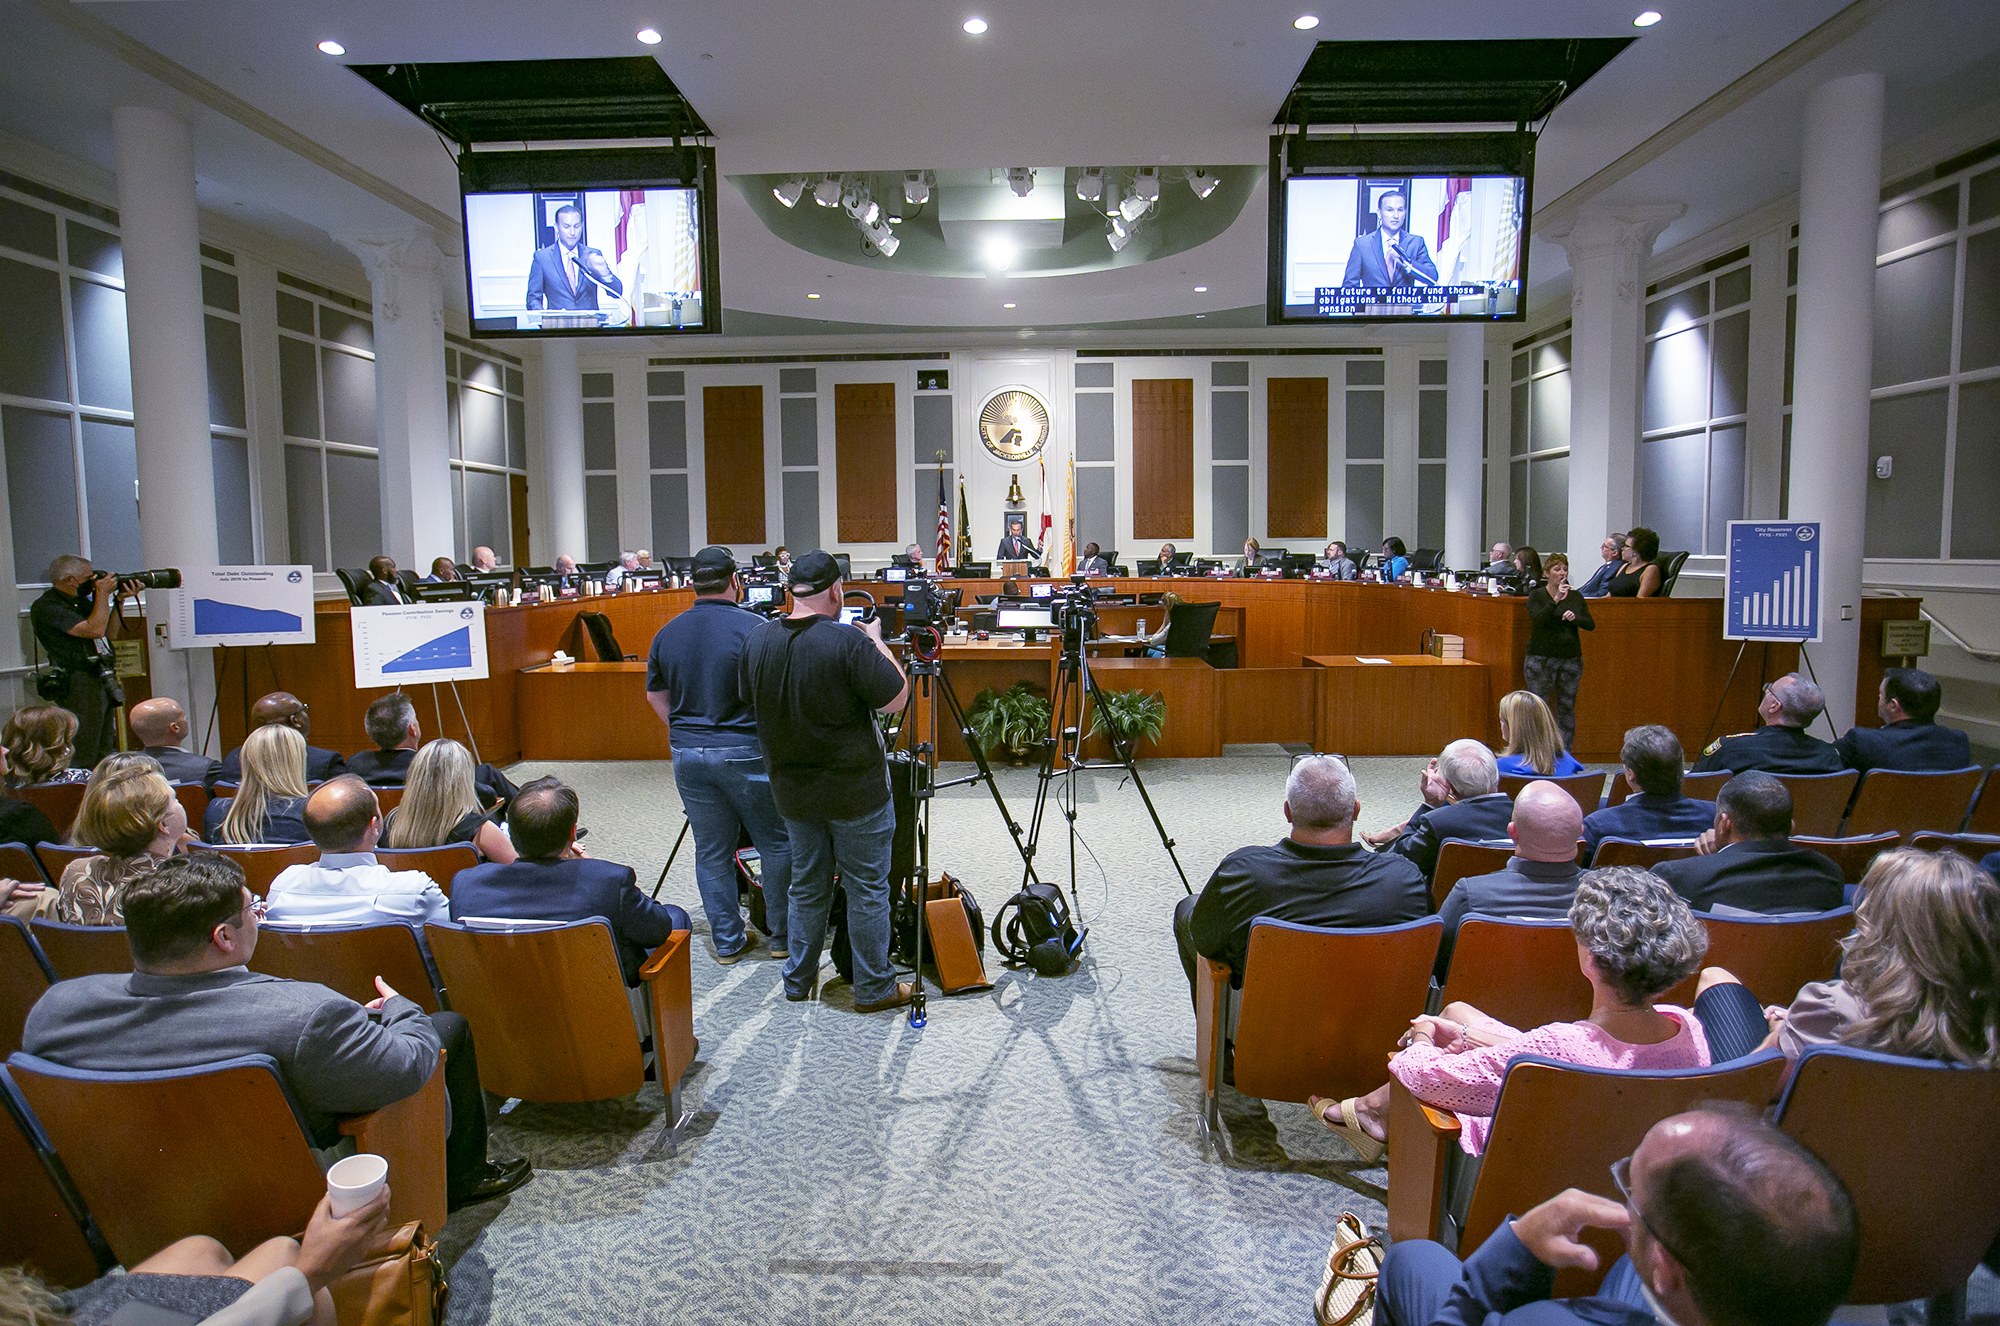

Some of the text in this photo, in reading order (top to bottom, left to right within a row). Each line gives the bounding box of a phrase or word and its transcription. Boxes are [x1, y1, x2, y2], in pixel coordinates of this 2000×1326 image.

[1319, 288, 1335, 296] the
[1340, 287, 1371, 295] future
[1376, 287, 1387, 295] to
[1391, 287, 1418, 296] fully
[1422, 287, 1443, 295] fund
[1319, 295, 1448, 305] obligations. Without this
[1319, 305, 1356, 314] pension
[980, 426, 988, 440] CITY
[986, 440, 994, 449] OF
